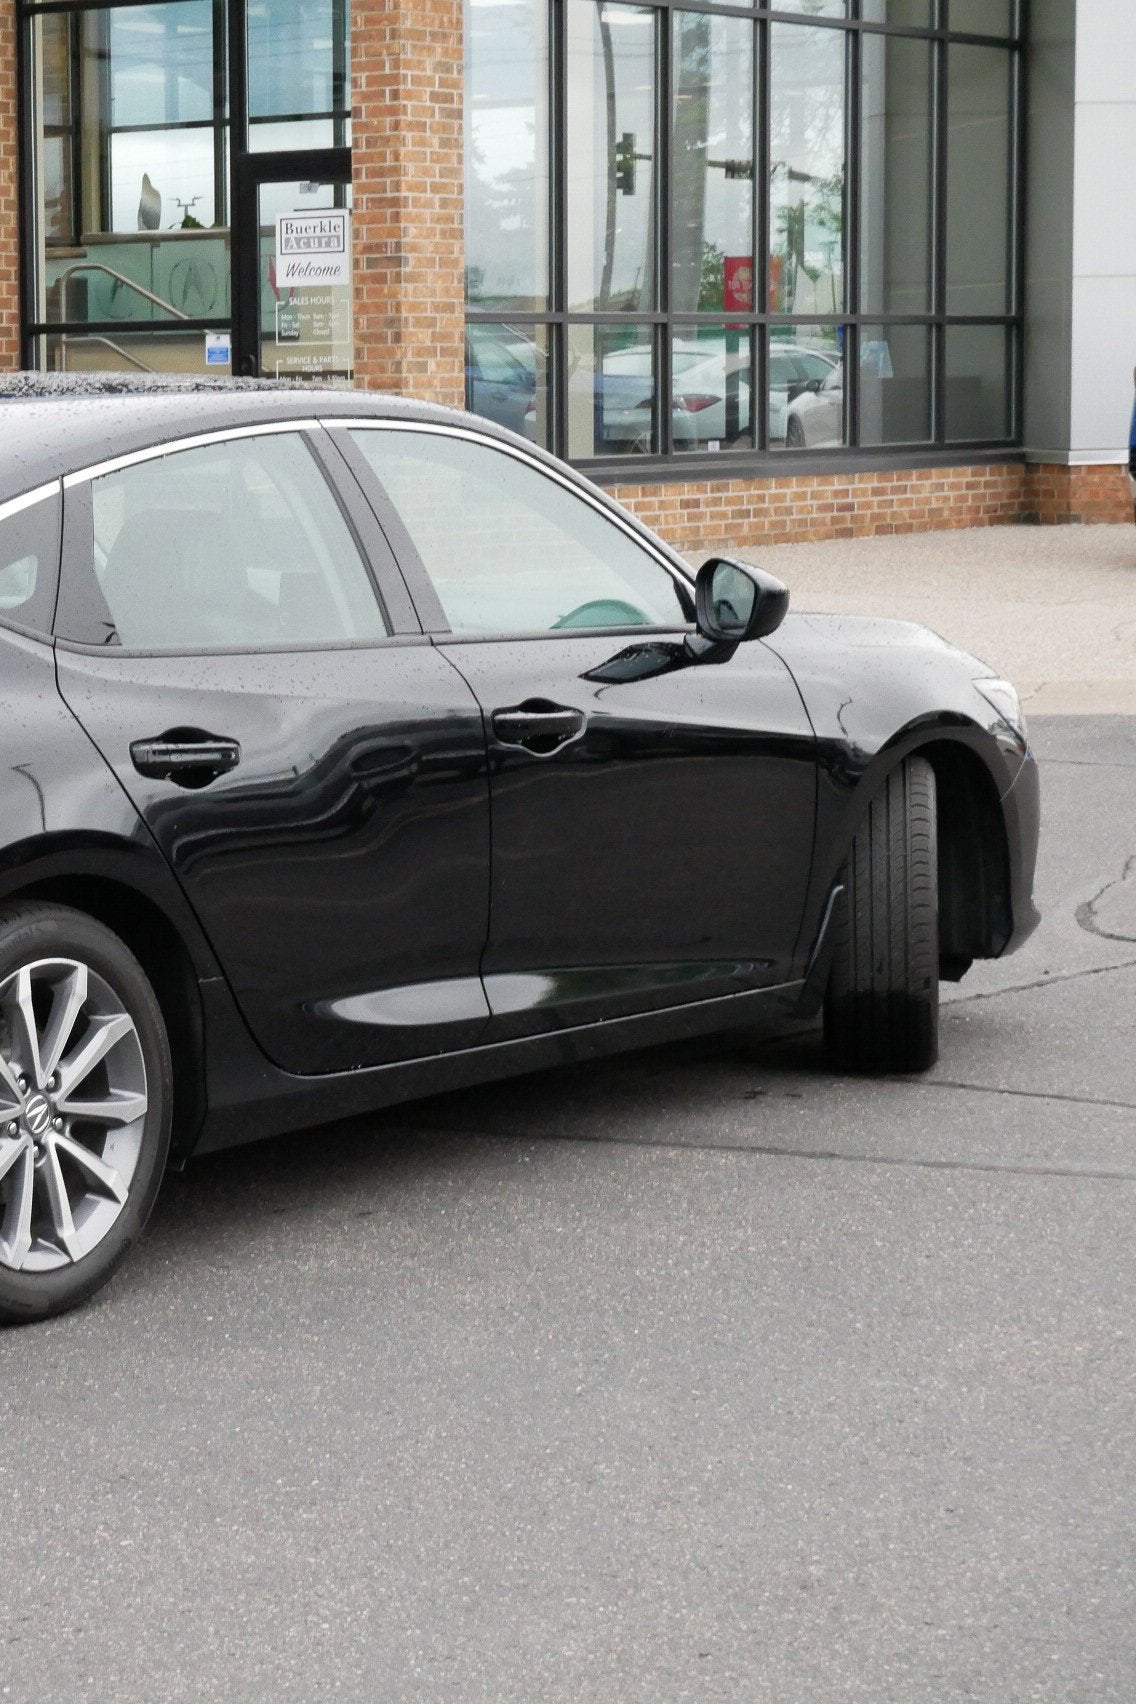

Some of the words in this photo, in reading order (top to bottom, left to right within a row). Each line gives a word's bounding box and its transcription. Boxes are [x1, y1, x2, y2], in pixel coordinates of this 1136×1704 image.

[284, 220, 341, 236] Buerkle
[286, 235, 339, 250] Acura
[285, 262, 342, 278] Welcome
[288, 297, 309, 305] SALES
[310, 296, 335, 304] HOURS
[281, 329, 299, 337] Sunday
[286, 356, 311, 365] SERVICE
